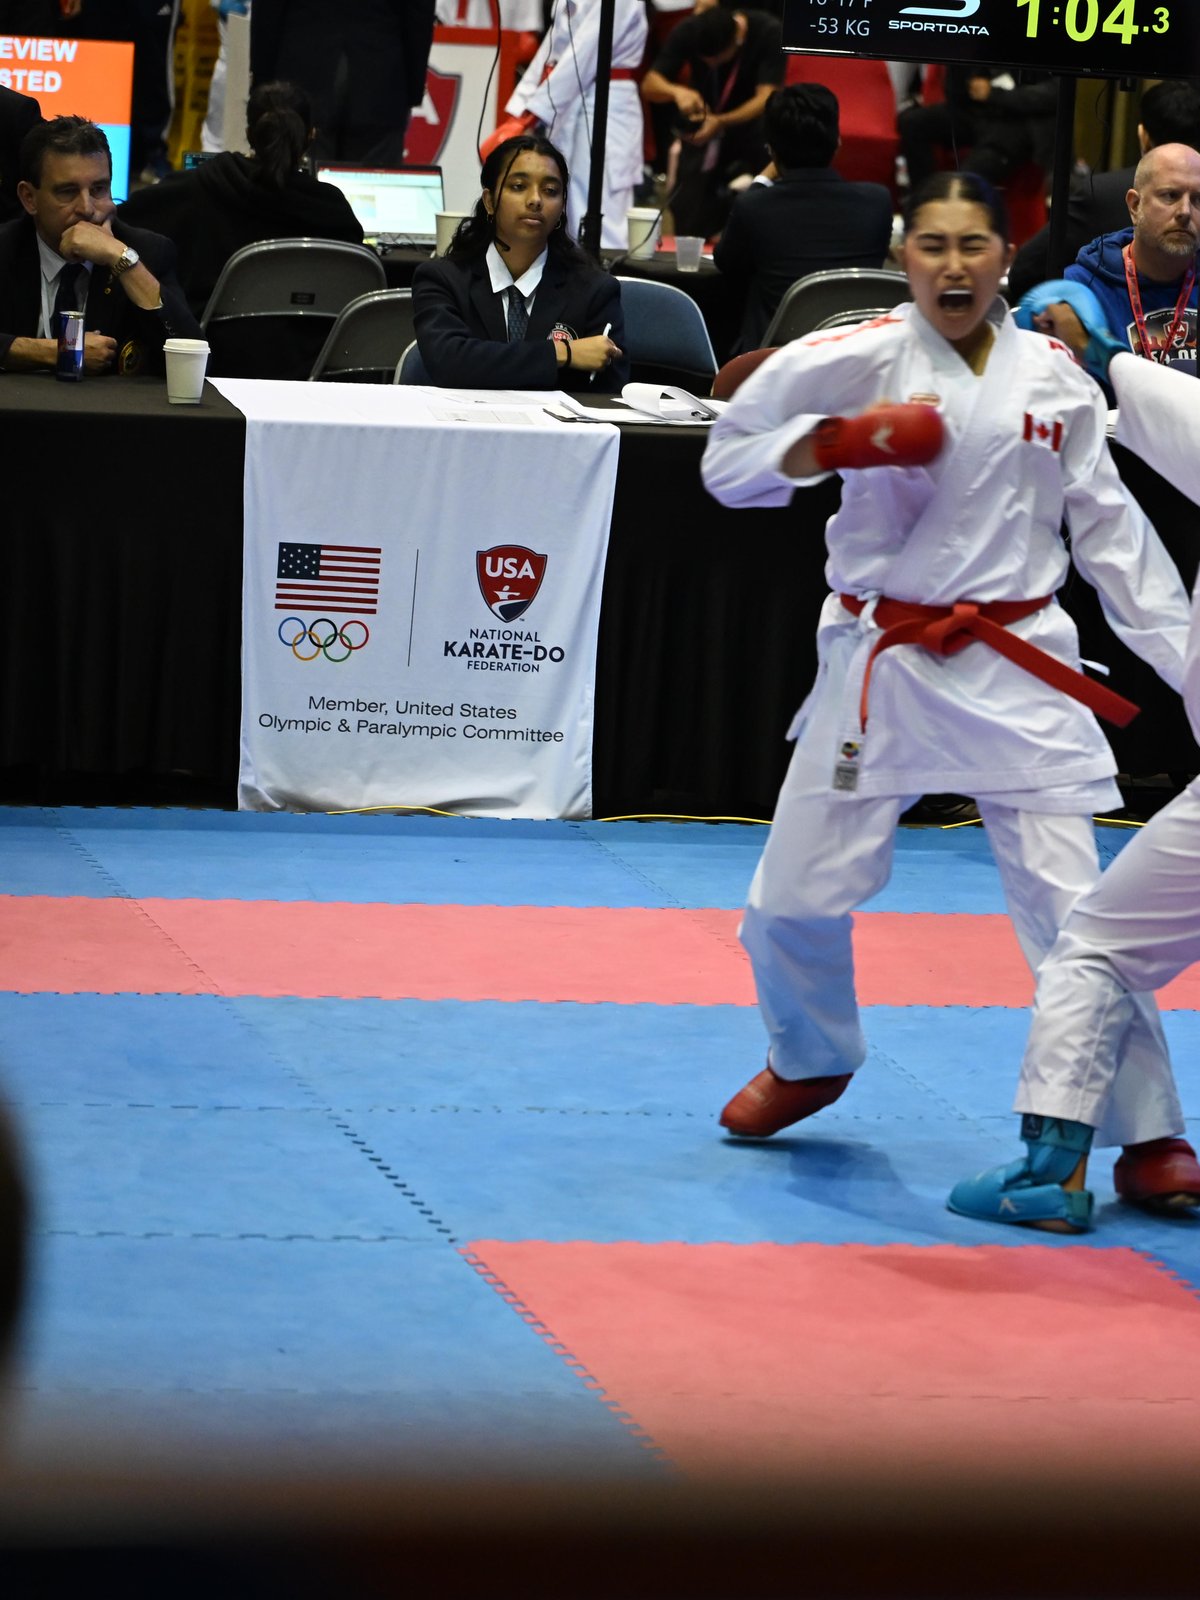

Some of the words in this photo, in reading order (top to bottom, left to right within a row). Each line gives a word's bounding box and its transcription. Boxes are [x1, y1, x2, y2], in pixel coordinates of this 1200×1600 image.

[810, 17, 838, 34] -53
[845, 19, 870, 36] KG
[888, 20, 990, 36] SPORTDATA
[485, 556, 536, 579] USA
[469, 628, 541, 642] NATIONAL
[443, 641, 565, 663] KARATE-DO
[467, 660, 540, 673] FEDERATION
[308, 696, 388, 716] Member,
[396, 700, 454, 717] United
[459, 703, 517, 719] States
[258, 713, 332, 733] Olympic
[337, 718, 351, 733] &
[357, 719, 457, 739] Paralympic
[462, 724, 564, 742] Committee
